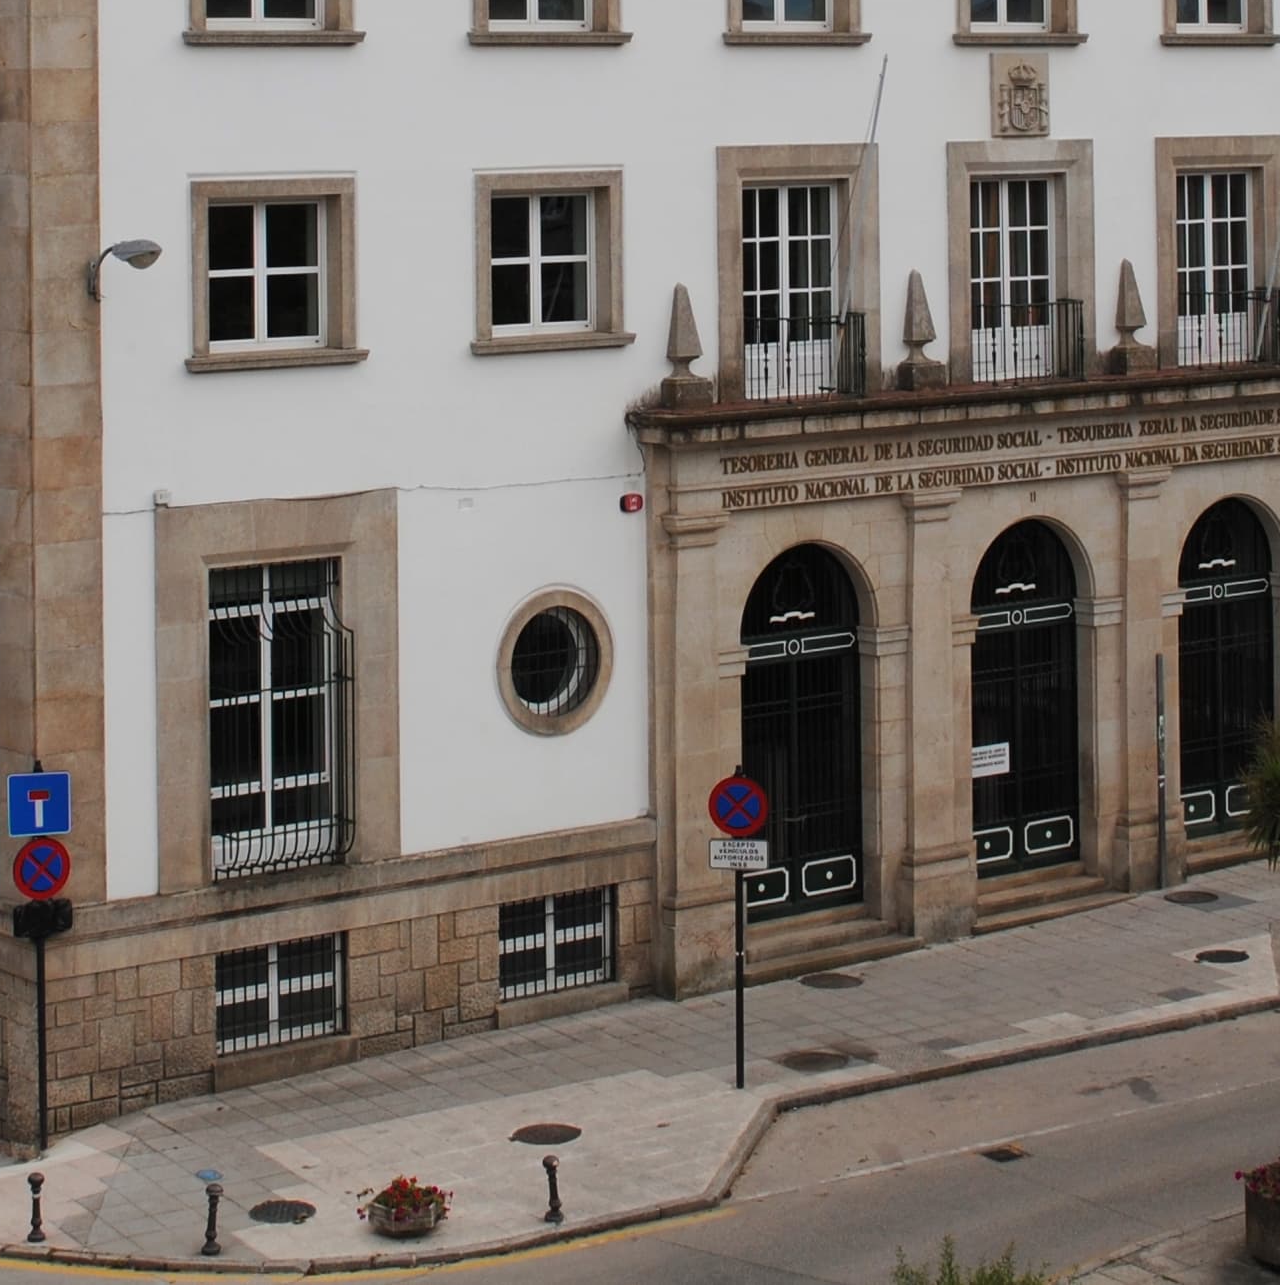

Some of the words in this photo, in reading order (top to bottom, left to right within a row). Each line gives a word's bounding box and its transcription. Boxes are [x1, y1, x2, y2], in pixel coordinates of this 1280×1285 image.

[719, 452, 799, 475] TESORERIA
[804, 445, 868, 467] GENERAL
[874, 442, 893, 460] DE
[896, 440, 914, 458] LA
[917, 434, 994, 456] SEGURIDAD
[997, 430, 1042, 448] SOCIAL
[1057, 422, 1133, 443] TESOURERIA
[1138, 417, 1178, 436] XERAL
[1181, 415, 1197, 433] DA
[1200, 409, 1275, 431] SEGURIDADE
[721, 485, 798, 508] INSTITUTO
[805, 478, 869, 500] NACIONAL
[874, 474, 893, 493] DE
[897, 473, 914, 491] LA
[918, 466, 994, 489] SEGURIDAD
[998, 461, 1043, 481] SOCIAL
[1056, 453, 1120, 475] INSTITUTO
[1125, 448, 1180, 469] NACIONAL
[1183, 445, 1198, 462] DA
[1200, 439, 1274, 460] SEGURIDADE
